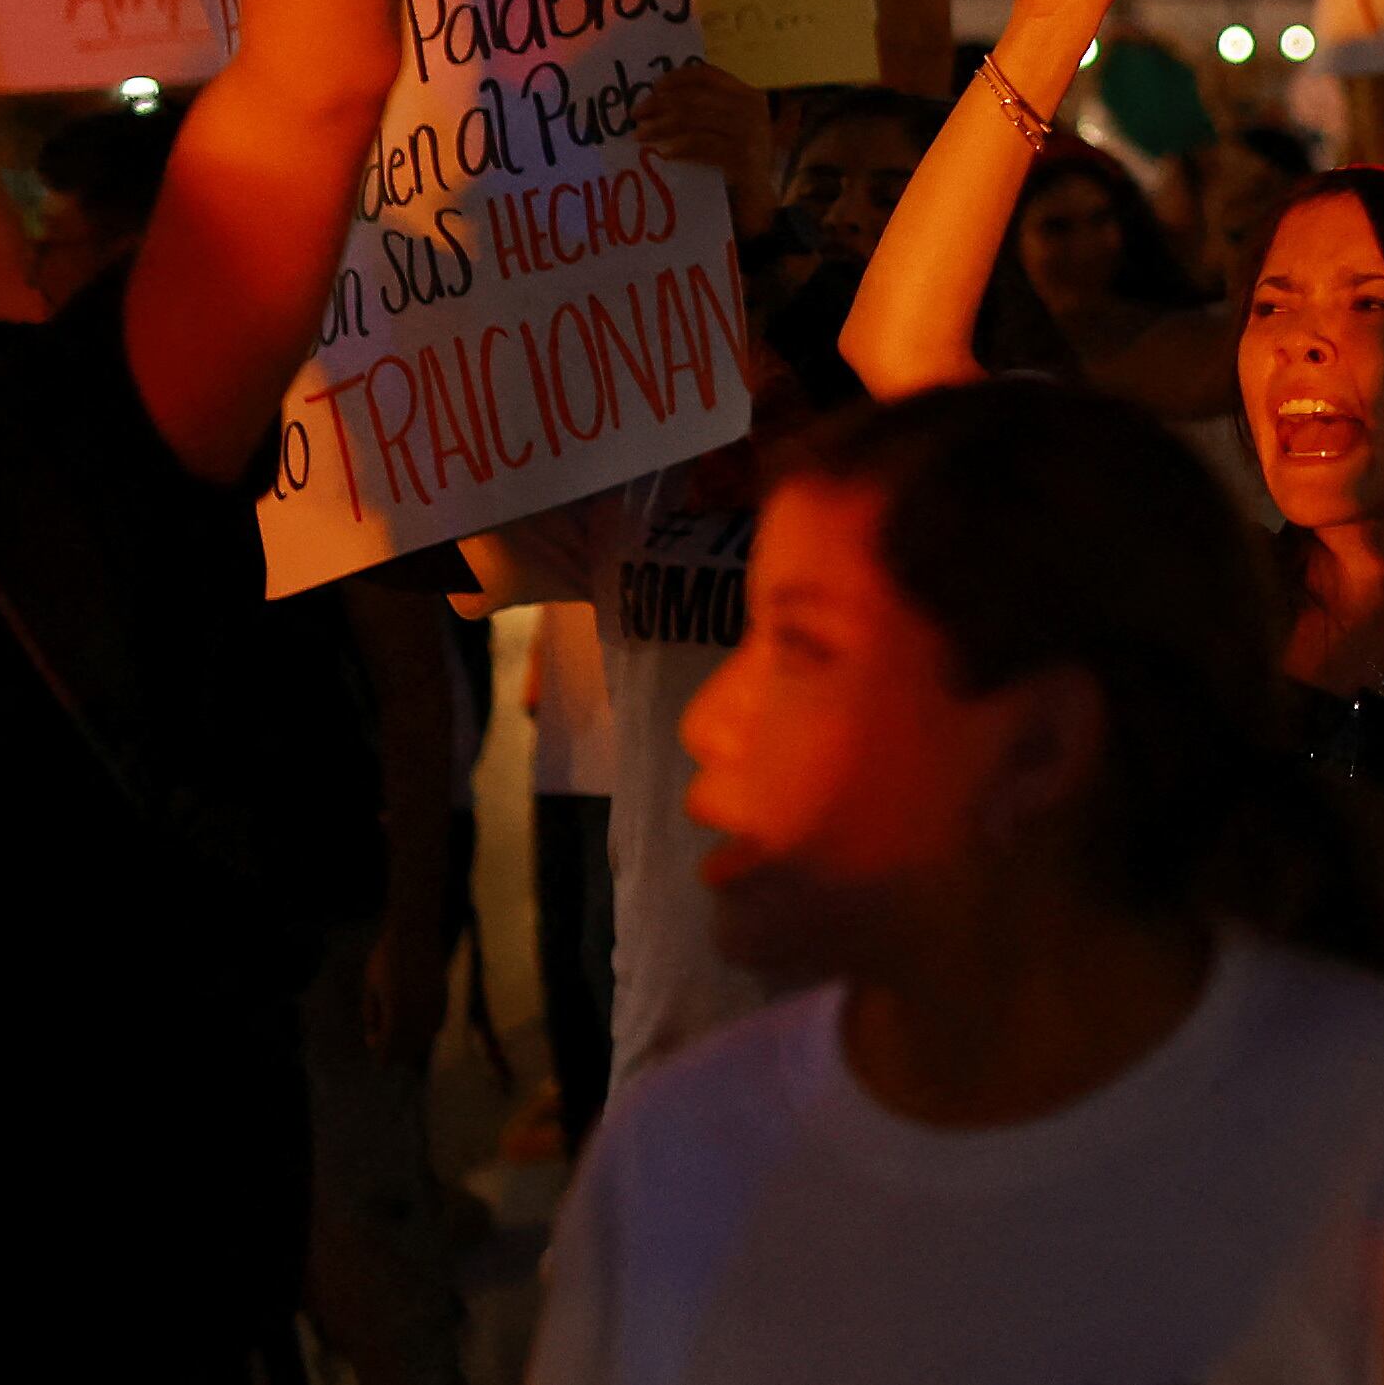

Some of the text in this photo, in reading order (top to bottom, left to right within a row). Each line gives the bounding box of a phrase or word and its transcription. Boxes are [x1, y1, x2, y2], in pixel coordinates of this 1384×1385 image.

[455, 76, 524, 177] al
[486, 146, 679, 280] HECHOS
[304, 242, 755, 524] TRAICIONAN
